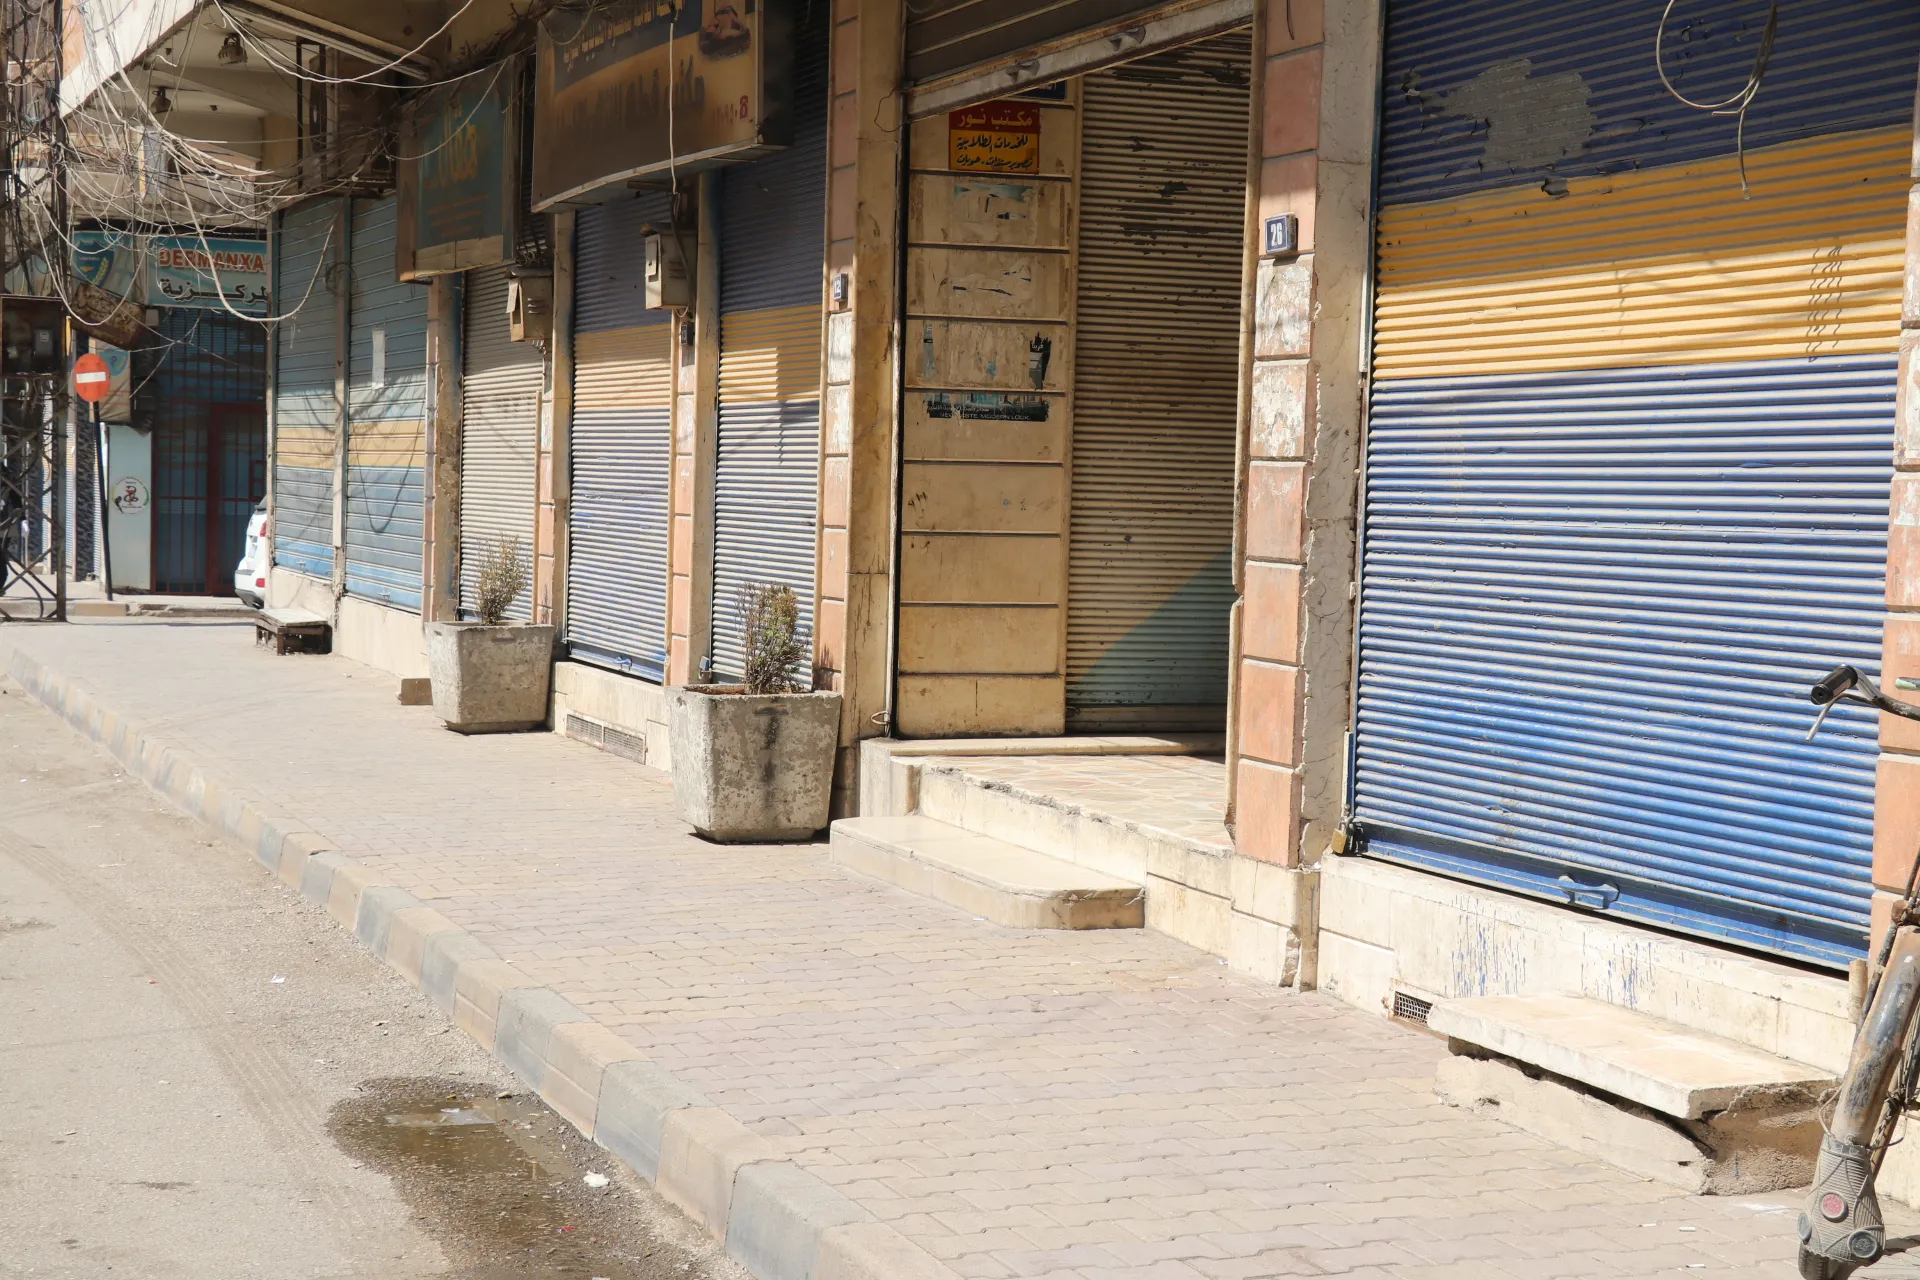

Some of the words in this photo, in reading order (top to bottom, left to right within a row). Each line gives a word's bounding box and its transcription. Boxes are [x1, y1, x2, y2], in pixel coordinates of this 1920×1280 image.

[958, 107, 987, 128] نور
[991, 109, 1033, 130] مكتب
[994, 134, 1029, 149] للخدمات
[1270, 222, 1283, 247] 26
